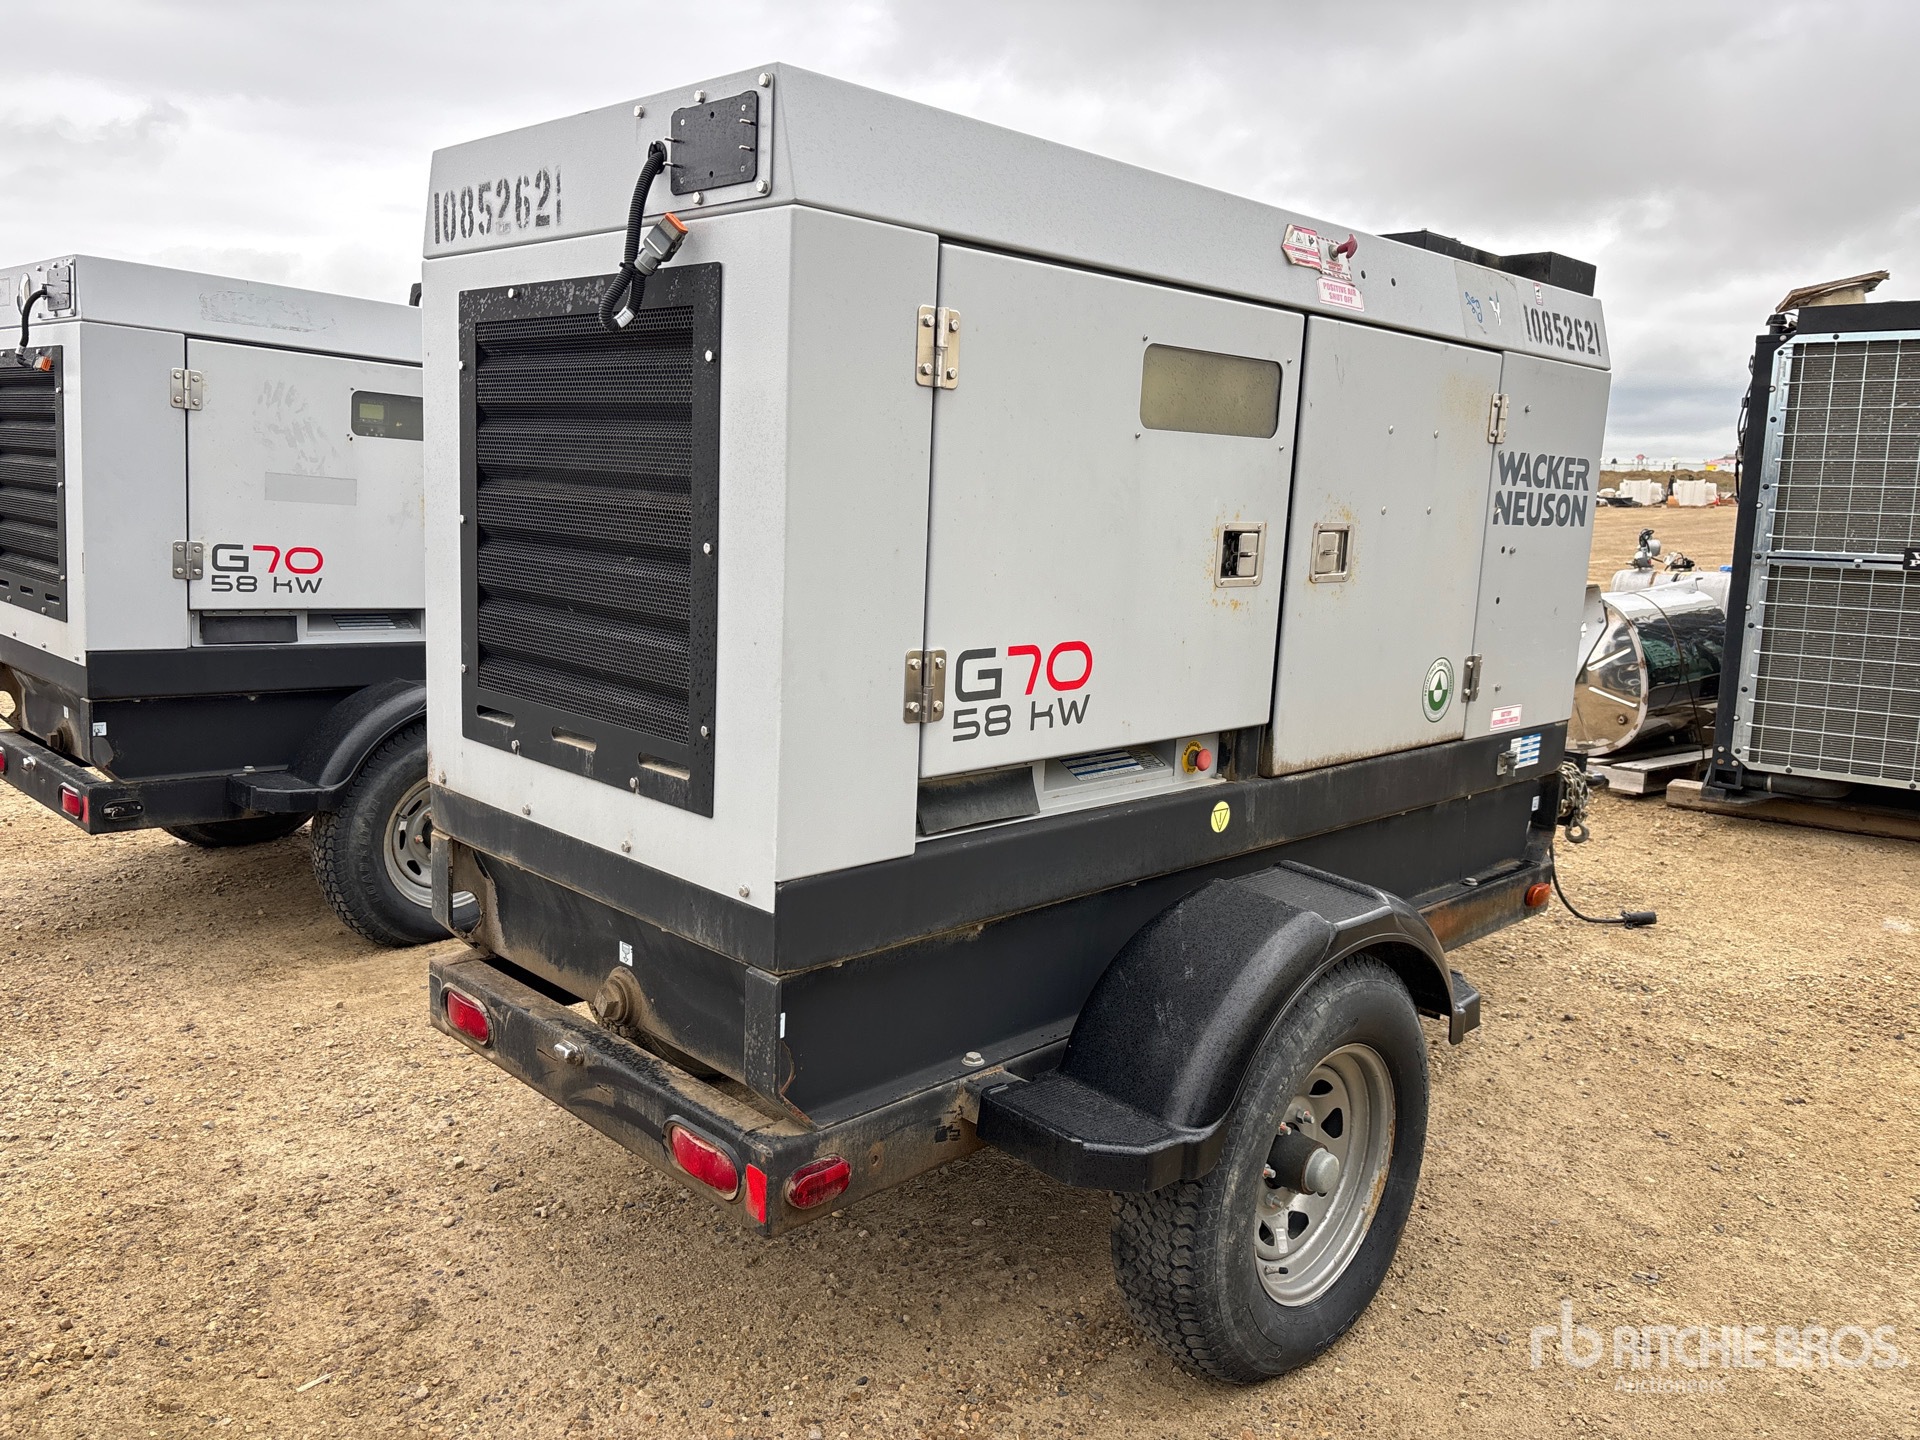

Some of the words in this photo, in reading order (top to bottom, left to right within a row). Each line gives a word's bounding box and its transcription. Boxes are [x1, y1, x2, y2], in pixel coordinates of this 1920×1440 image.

[434, 165, 561, 244] 10852621
[1523, 304, 1602, 356] 10852621
[1498, 450, 1590, 491] WACKER
[1493, 490, 1588, 527] NEUSON
[211, 543, 324, 575] G70
[211, 574, 258, 593] 58
[955, 640, 1093, 702] G70
[952, 704, 1012, 742] 58
